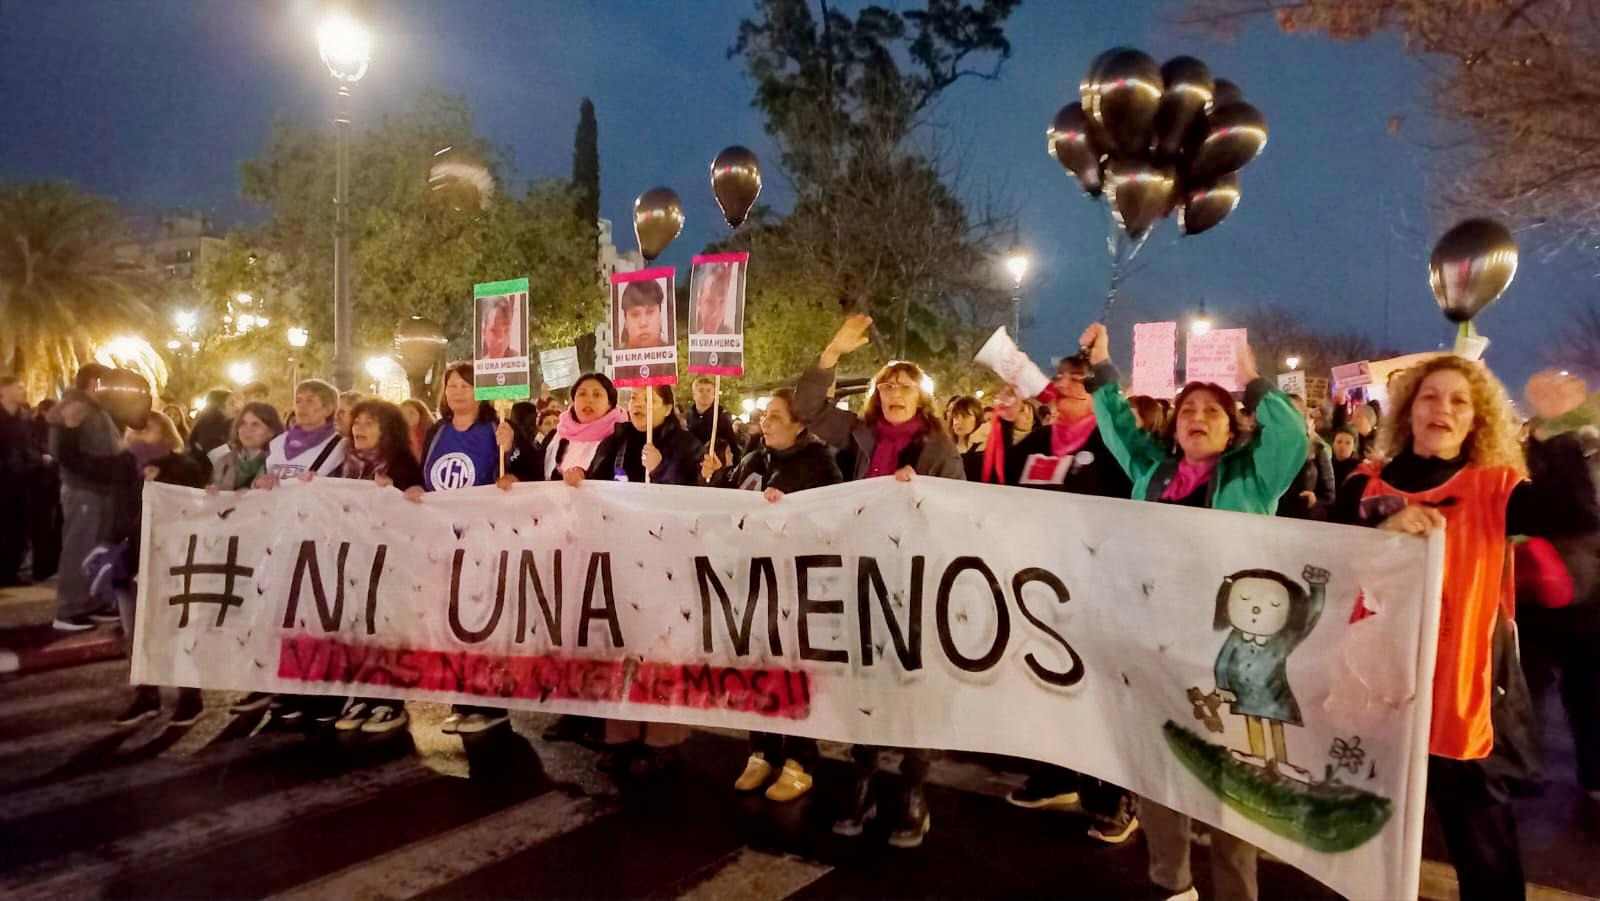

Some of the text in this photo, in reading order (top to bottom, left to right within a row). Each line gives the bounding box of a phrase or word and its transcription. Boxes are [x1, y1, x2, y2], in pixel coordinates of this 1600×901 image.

[698, 338, 715, 347] UNA
[715, 338, 740, 348] MENOS
[615, 350, 674, 362] NI UNA MENOS
[484, 360, 500, 370] UNA
[447, 549, 625, 648] UNA
[694, 555, 1085, 687] MENOS
[279, 636, 421, 690] VIVAS
